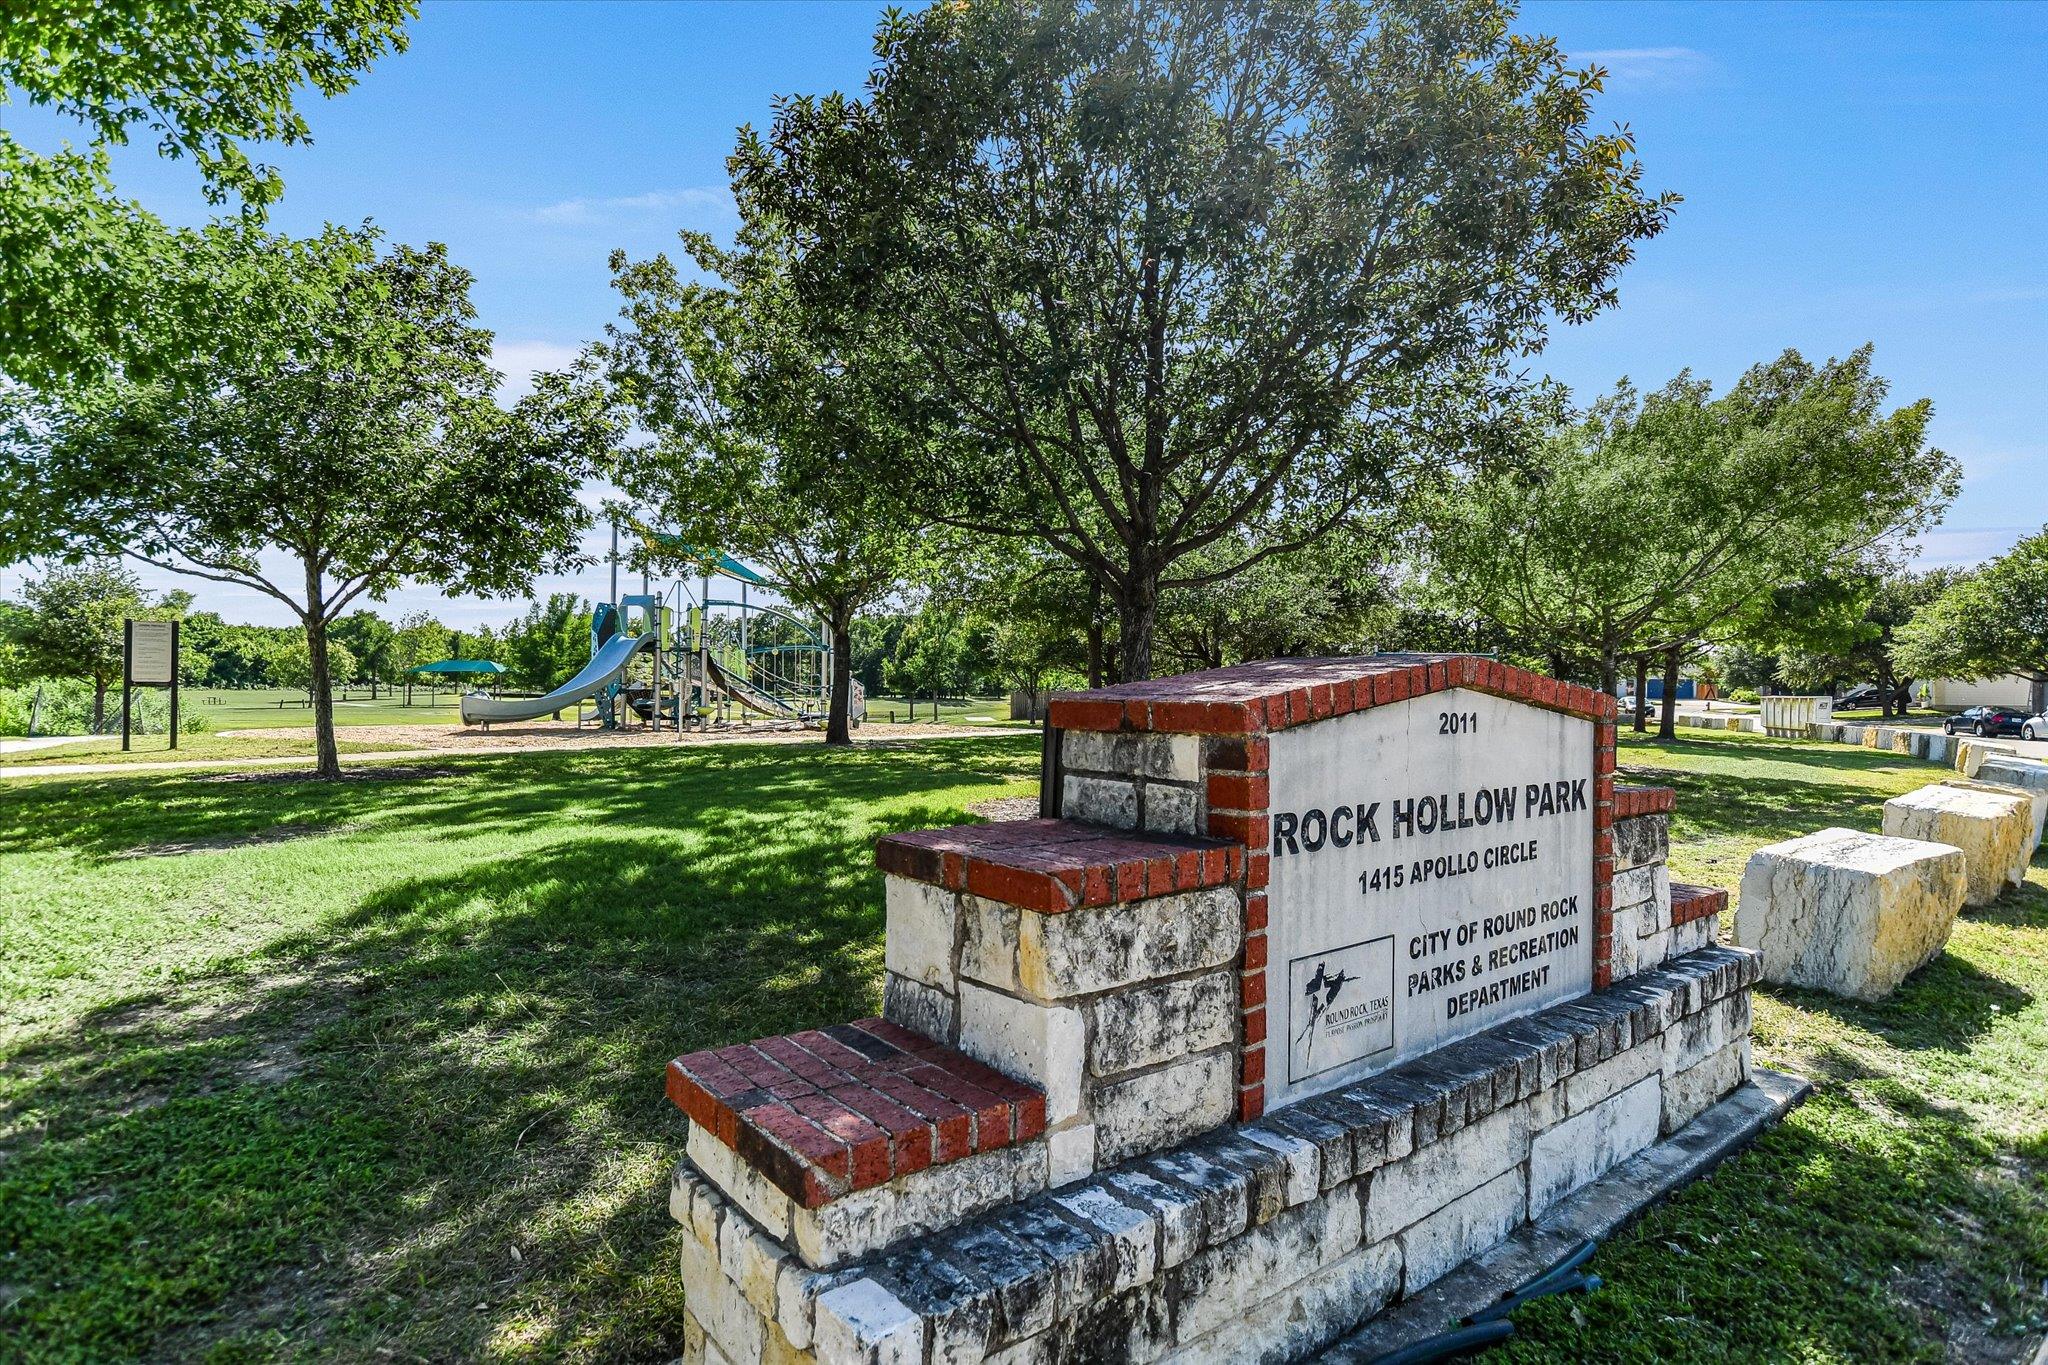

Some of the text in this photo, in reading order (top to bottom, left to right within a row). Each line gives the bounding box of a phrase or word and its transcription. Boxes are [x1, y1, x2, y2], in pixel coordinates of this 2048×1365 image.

[1439, 712, 1477, 735] 2011
[1273, 778, 1587, 858] ROCK HOLLOW PARK
[1358, 840, 1538, 894] 1415 APOLLO CIRCLE
[1409, 895, 1578, 960] CITY OF ROUND ROCK
[1408, 925, 1579, 997] PARKS & RECREATION
[1325, 1008, 1349, 1026] ROUND
[1370, 995, 1389, 1011] TEXAS
[1447, 964, 1550, 1020] DEPARTMENT
